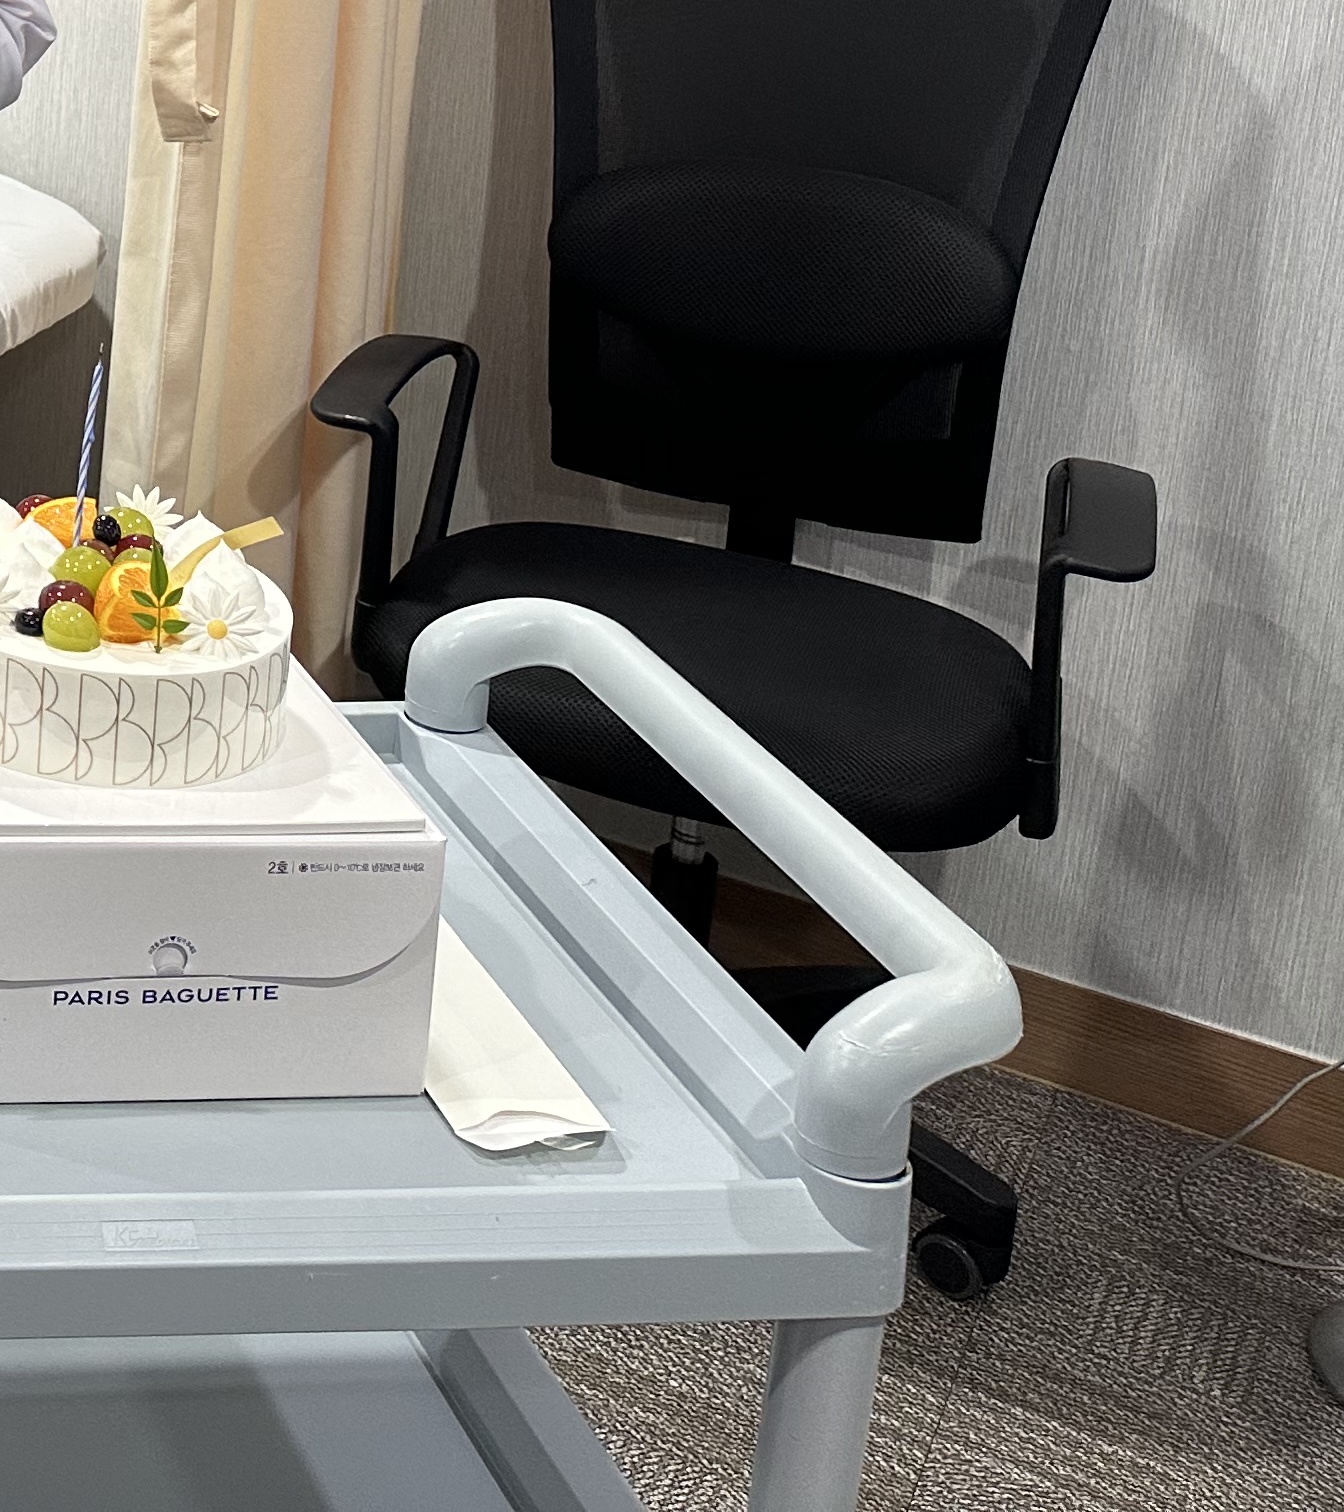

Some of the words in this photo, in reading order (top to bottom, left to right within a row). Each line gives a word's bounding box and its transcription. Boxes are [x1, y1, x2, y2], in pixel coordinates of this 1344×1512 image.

[267, 860, 289, 875] 2호
[53, 989, 130, 1006] PARIS
[141, 985, 280, 1005] BAGUETTE
